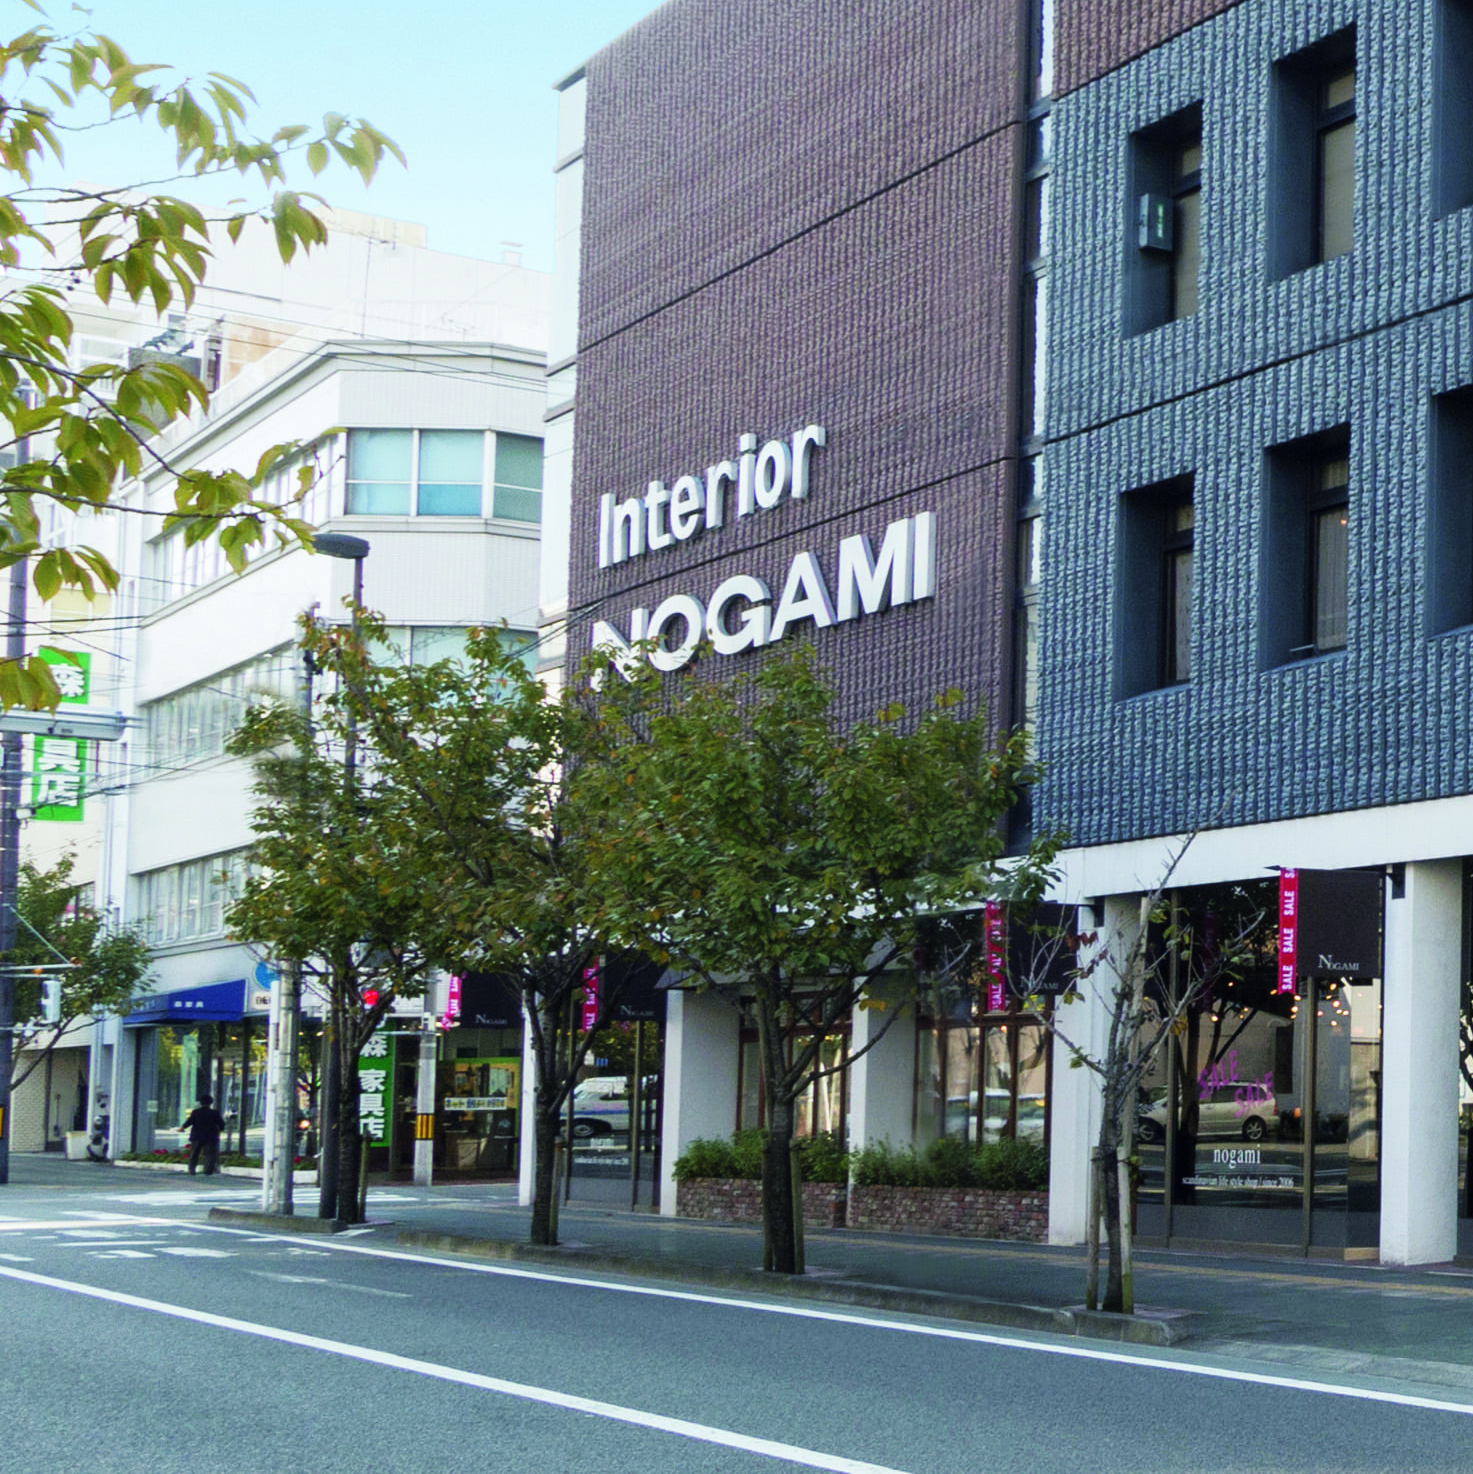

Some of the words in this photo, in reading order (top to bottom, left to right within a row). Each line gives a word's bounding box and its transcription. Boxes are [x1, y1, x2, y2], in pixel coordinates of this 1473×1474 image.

[599, 424, 826, 569] Interior
[590, 510, 936, 692] NOGAMI
[1284, 890, 1294, 916] SALE
[1282, 928, 1294, 954] SALE
[1318, 954, 1360, 971] NOGAMI
[1281, 965, 1293, 990] SALE
[1198, 1049, 1240, 1100] SALE
[1233, 1071, 1274, 1118] SALE
[1213, 1143, 1261, 1169] nogami
